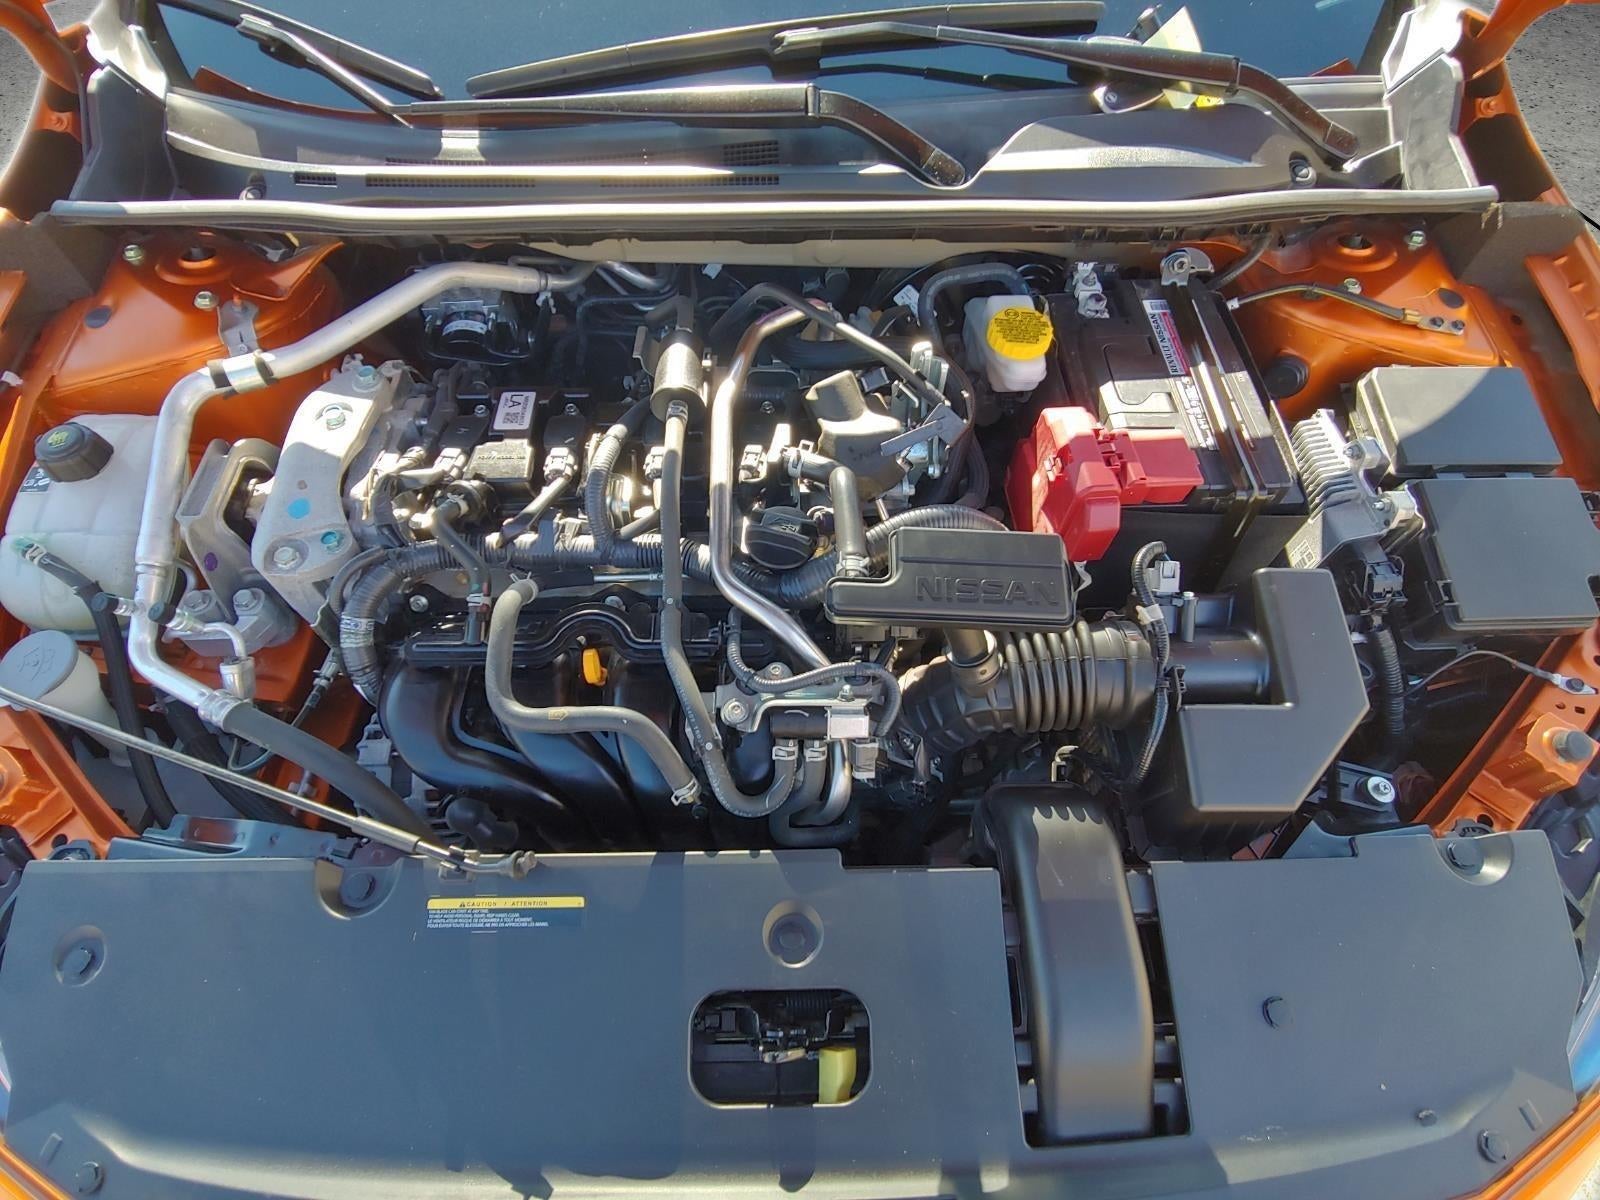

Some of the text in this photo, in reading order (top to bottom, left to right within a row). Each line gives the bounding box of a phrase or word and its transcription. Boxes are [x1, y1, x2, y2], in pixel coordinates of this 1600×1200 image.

[1149, 313, 1178, 374] RENAULT NISSAN
[915, 576, 1060, 606] NISSAN
